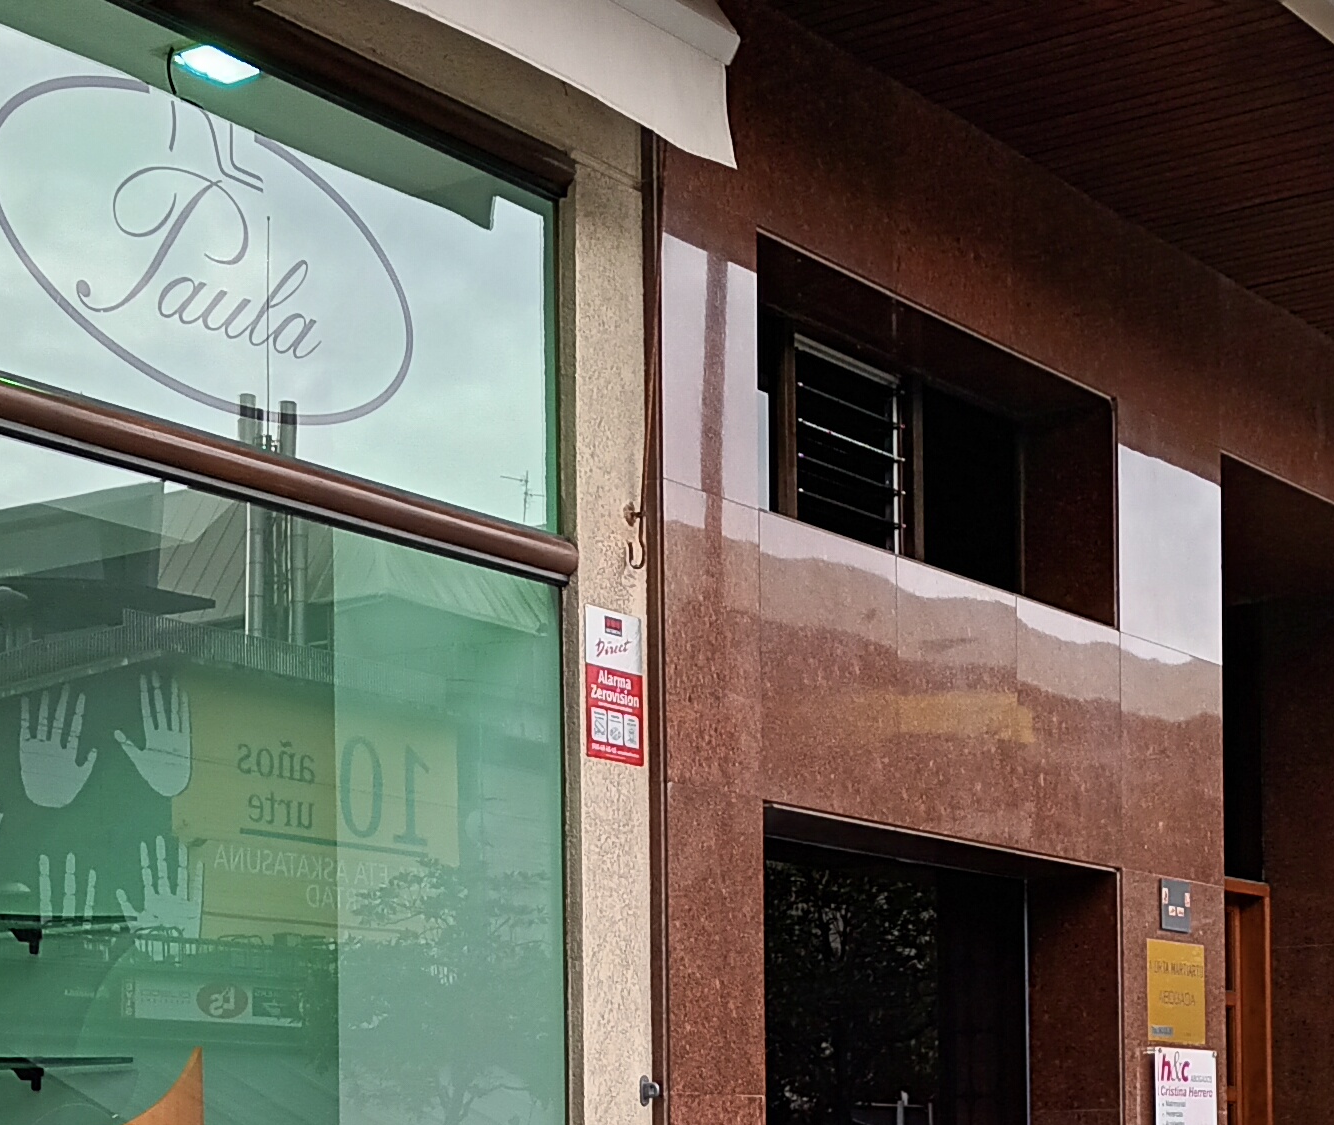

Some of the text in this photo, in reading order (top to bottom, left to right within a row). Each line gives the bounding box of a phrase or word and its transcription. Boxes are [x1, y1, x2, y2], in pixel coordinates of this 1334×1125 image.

[75, 165, 322, 360] Paula
[595, 638, 633, 658] Direct
[598, 669, 631, 691] Alarma
[1160, 1085, 1213, 1098] Cristina Herrero
